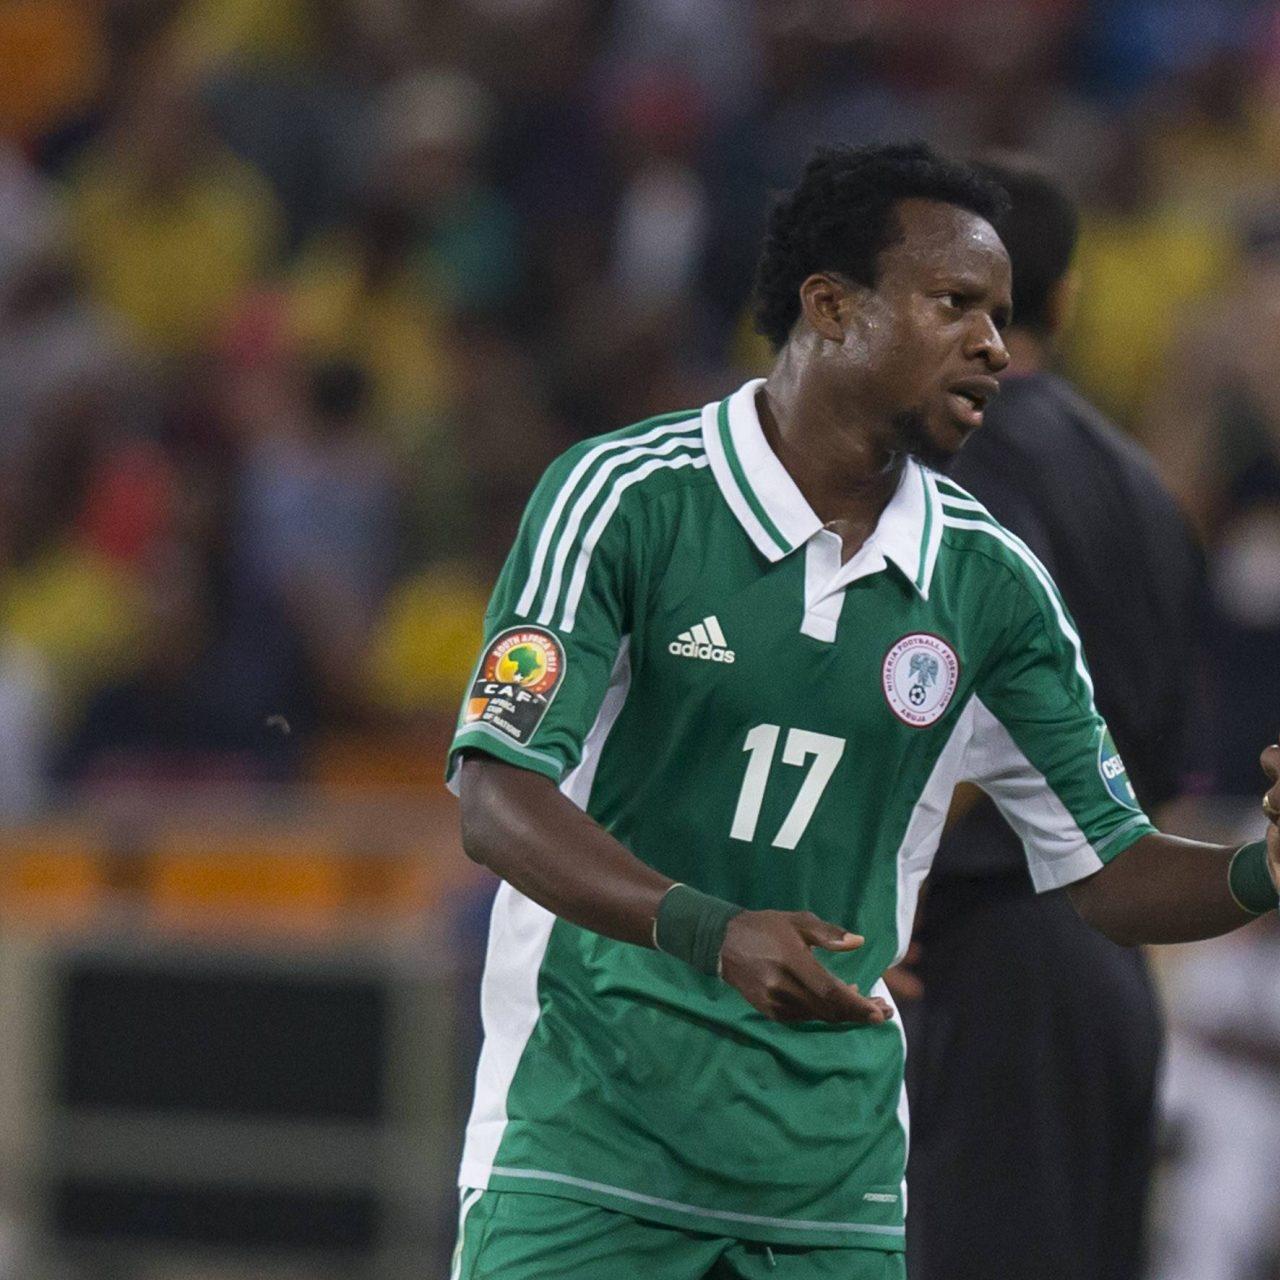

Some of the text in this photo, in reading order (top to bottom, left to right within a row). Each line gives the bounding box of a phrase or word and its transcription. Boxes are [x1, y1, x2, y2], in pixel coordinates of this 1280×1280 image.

[492, 634, 520, 657] SOUTH
[521, 633, 551, 650] AFRICA
[668, 642, 735, 664] adidas
[885, 638, 956, 708] NIGERIA FOOTBALL FEDERATION
[729, 723, 847, 851] 17
